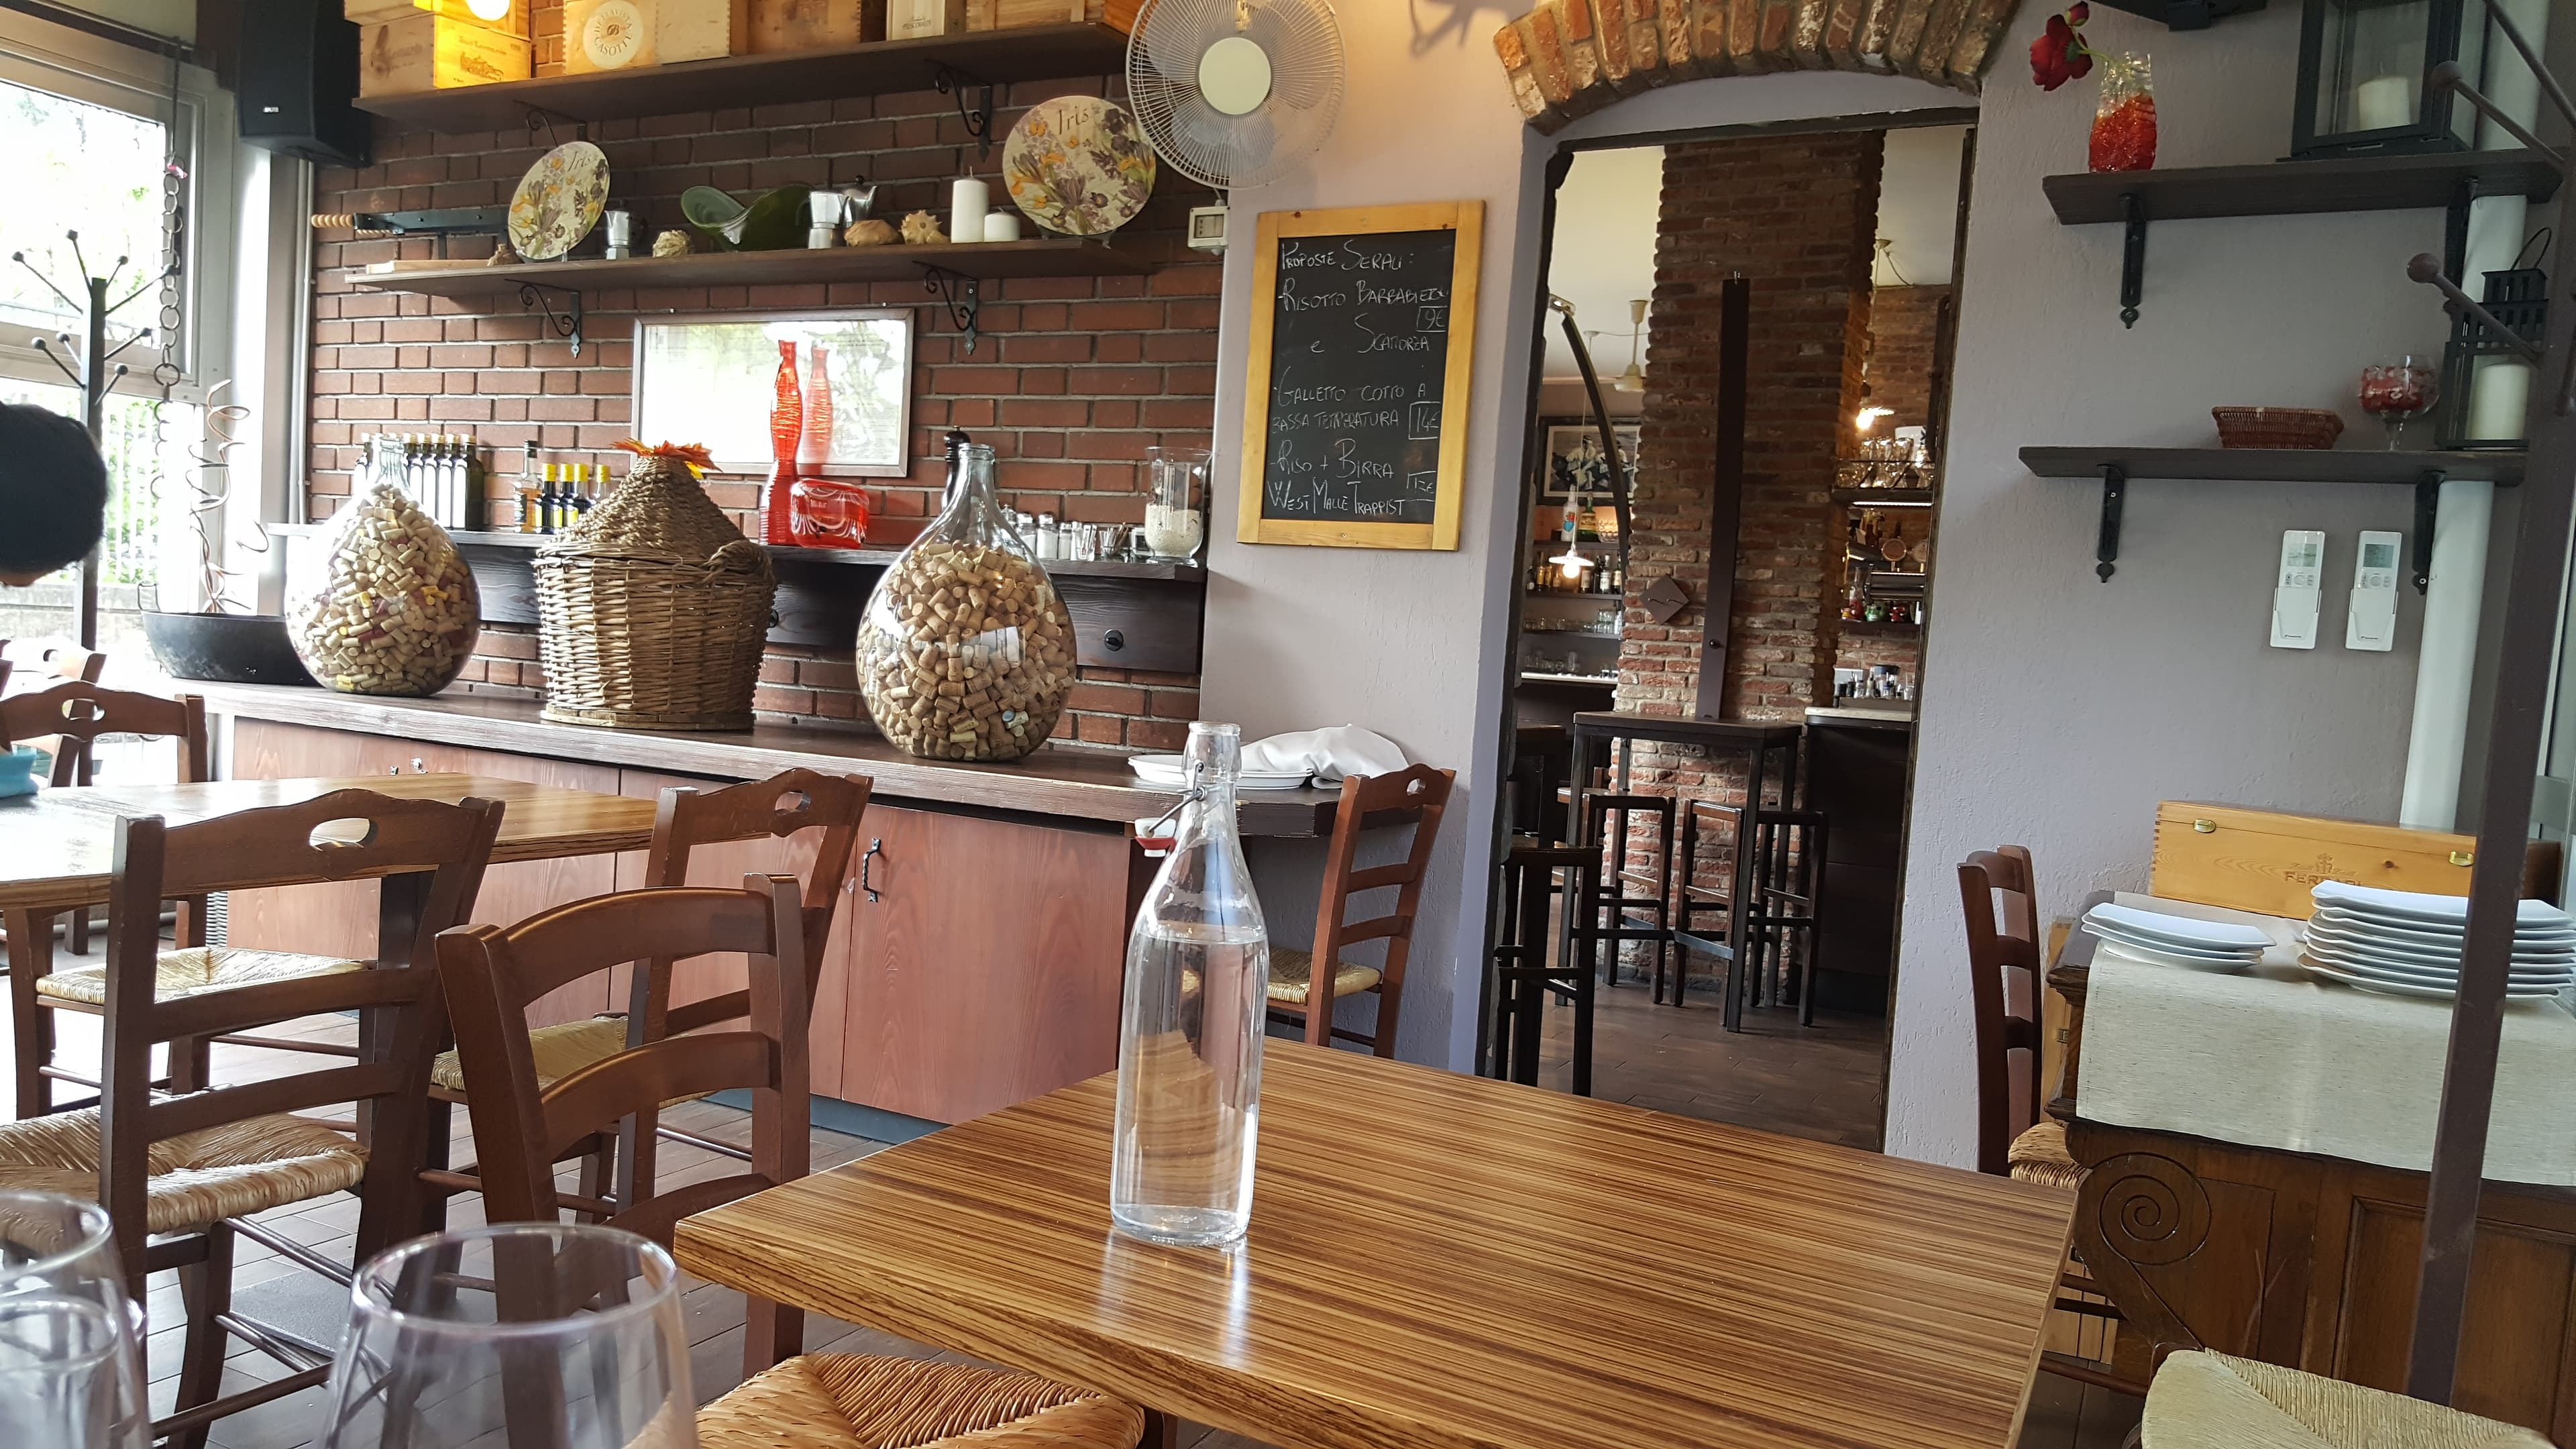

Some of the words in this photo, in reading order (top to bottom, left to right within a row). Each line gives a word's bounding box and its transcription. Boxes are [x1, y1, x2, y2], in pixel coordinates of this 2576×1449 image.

[1059, 105, 1089, 135] Iris
[568, 151, 592, 172] Iris
[1282, 242, 1336, 270] PROPOSTE
[1361, 385, 1405, 401] COTTO
[1417, 382, 1427, 398] A
[1334, 438, 1394, 478] BIRRA
[1347, 481, 1405, 515] TRAPPIST
[2284, 871, 2361, 887] FERR
